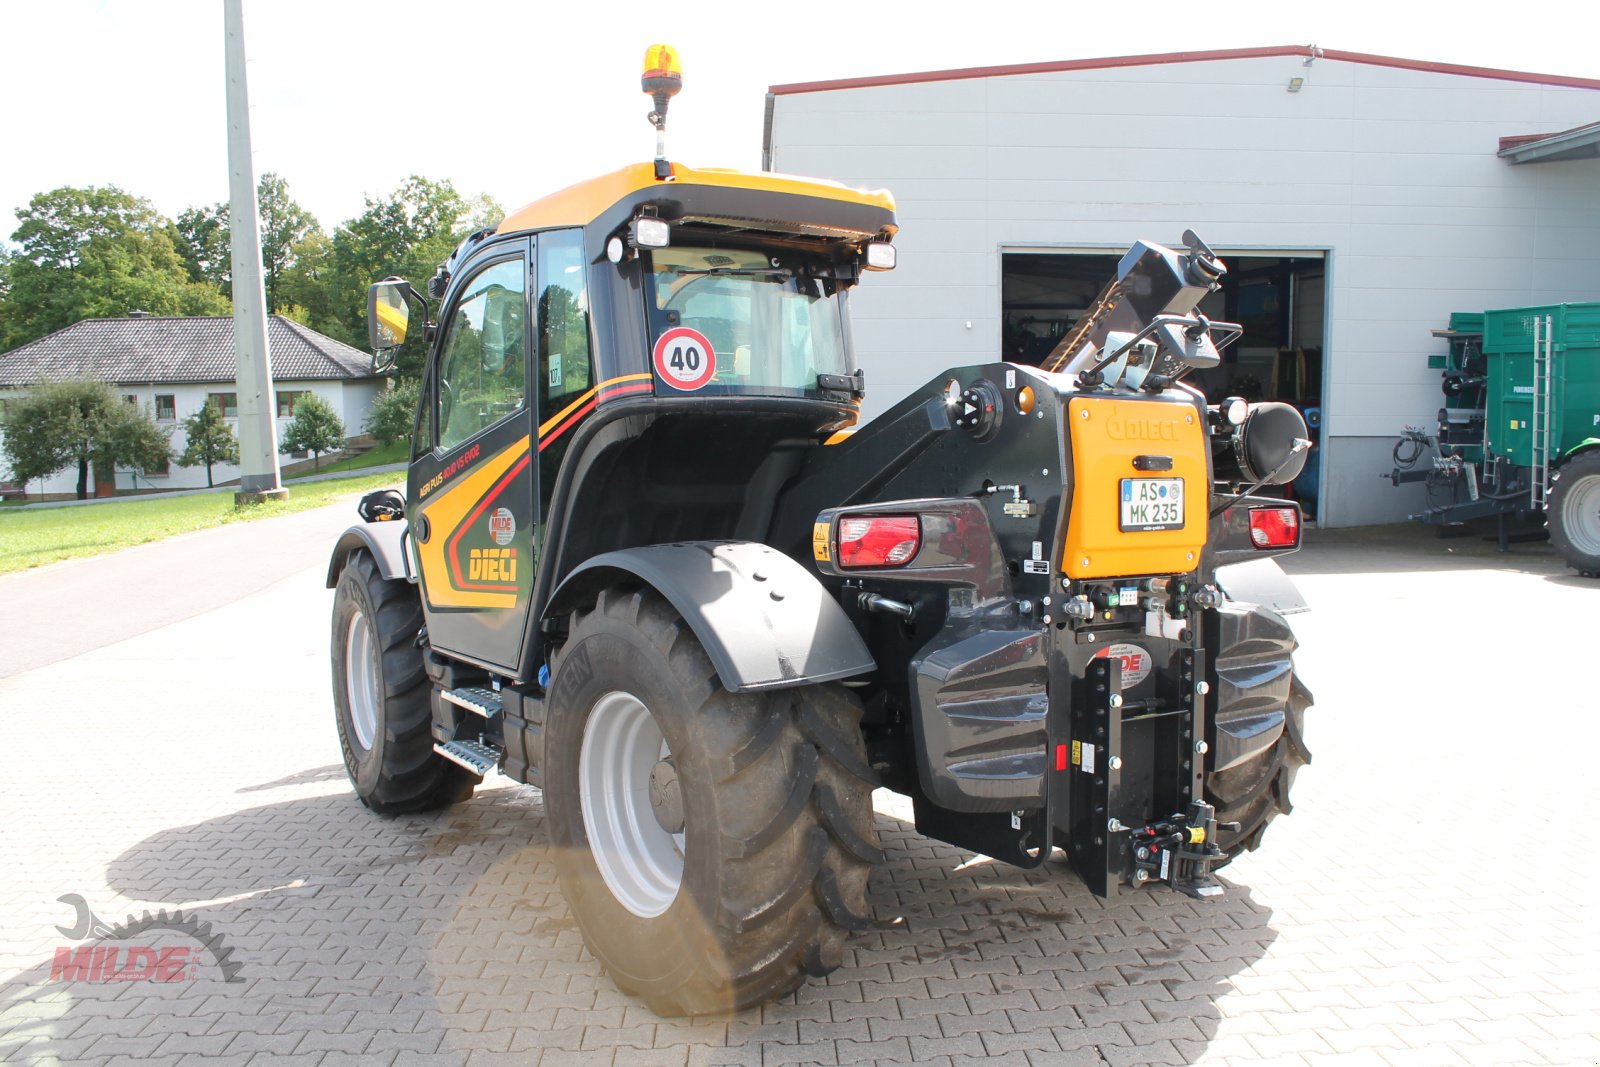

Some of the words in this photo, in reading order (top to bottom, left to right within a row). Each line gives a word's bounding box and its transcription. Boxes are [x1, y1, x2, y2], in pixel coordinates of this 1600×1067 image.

[670, 346, 700, 371] 40
[431, 472, 443, 490] PLUS
[1139, 482, 1158, 501] AS
[1130, 504, 1149, 523] MK
[1152, 503, 1178, 522] 235
[491, 517, 512, 531] MILDE
